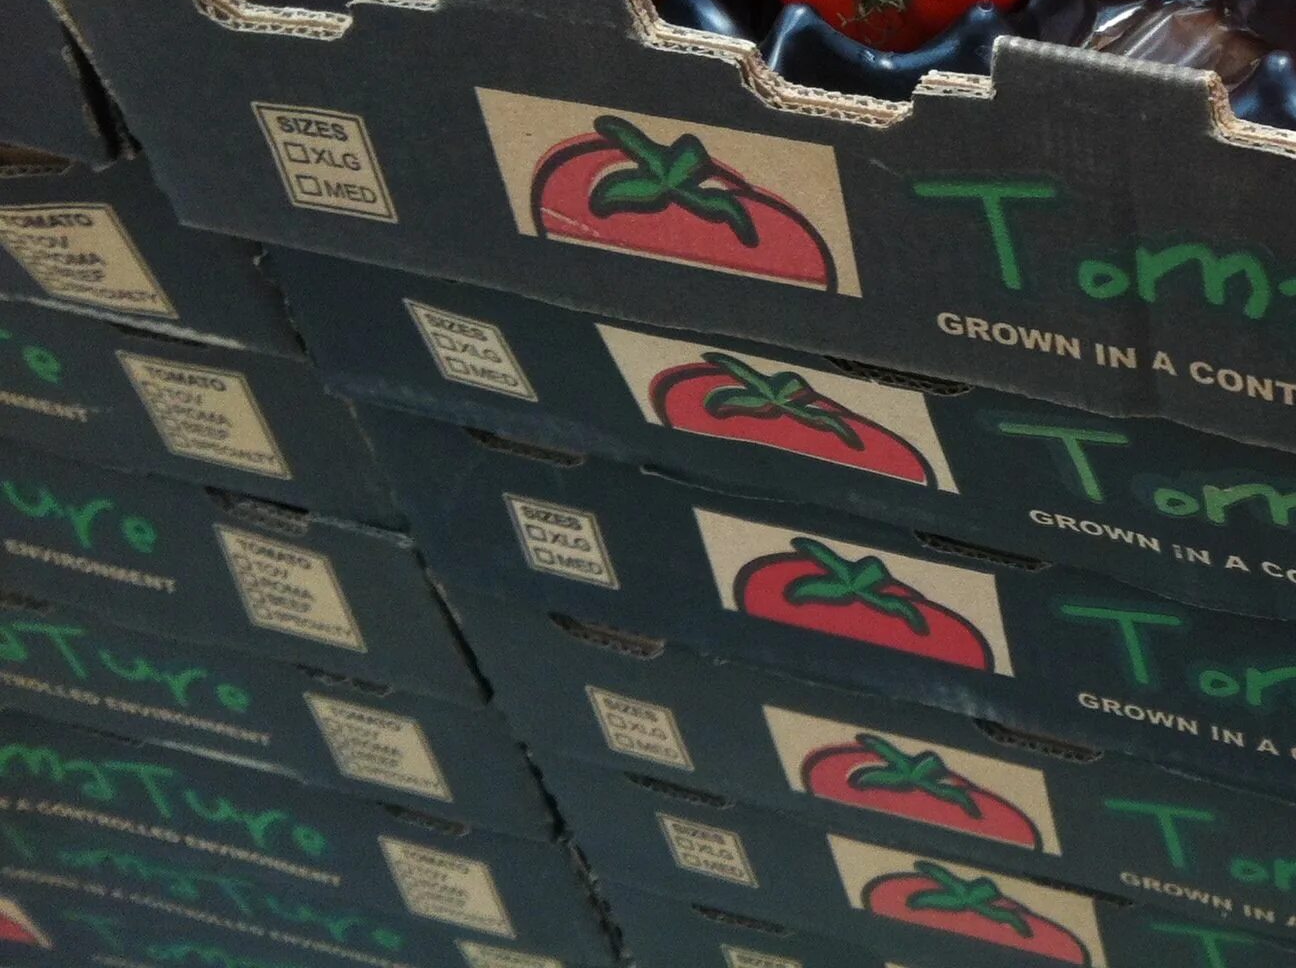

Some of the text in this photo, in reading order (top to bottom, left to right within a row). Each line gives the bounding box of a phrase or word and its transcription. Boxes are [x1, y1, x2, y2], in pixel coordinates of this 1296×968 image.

[277, 116, 348, 142] SIZES
[311, 147, 361, 171] XLG
[323, 179, 377, 204] MED
[424, 313, 487, 342] SIZES
[456, 340, 502, 363] XLG
[936, 311, 1082, 360] GROWN
[1094, 342, 1138, 370] IN
[1152, 350, 1179, 376] A
[469, 363, 519, 387] MED
[521, 505, 583, 530] SIZES
[1029, 509, 1161, 553] GROWN
[1171, 543, 1212, 566] IN
[1225, 555, 1251, 573] A
[556, 553, 603, 575] MED
[1078, 692, 1198, 735] GROWN
[1210, 724, 1245, 748] IN
[1257, 737, 1280, 756] A
[1119, 871, 1234, 912] GROWN
[1242, 904, 1277, 925] IN
